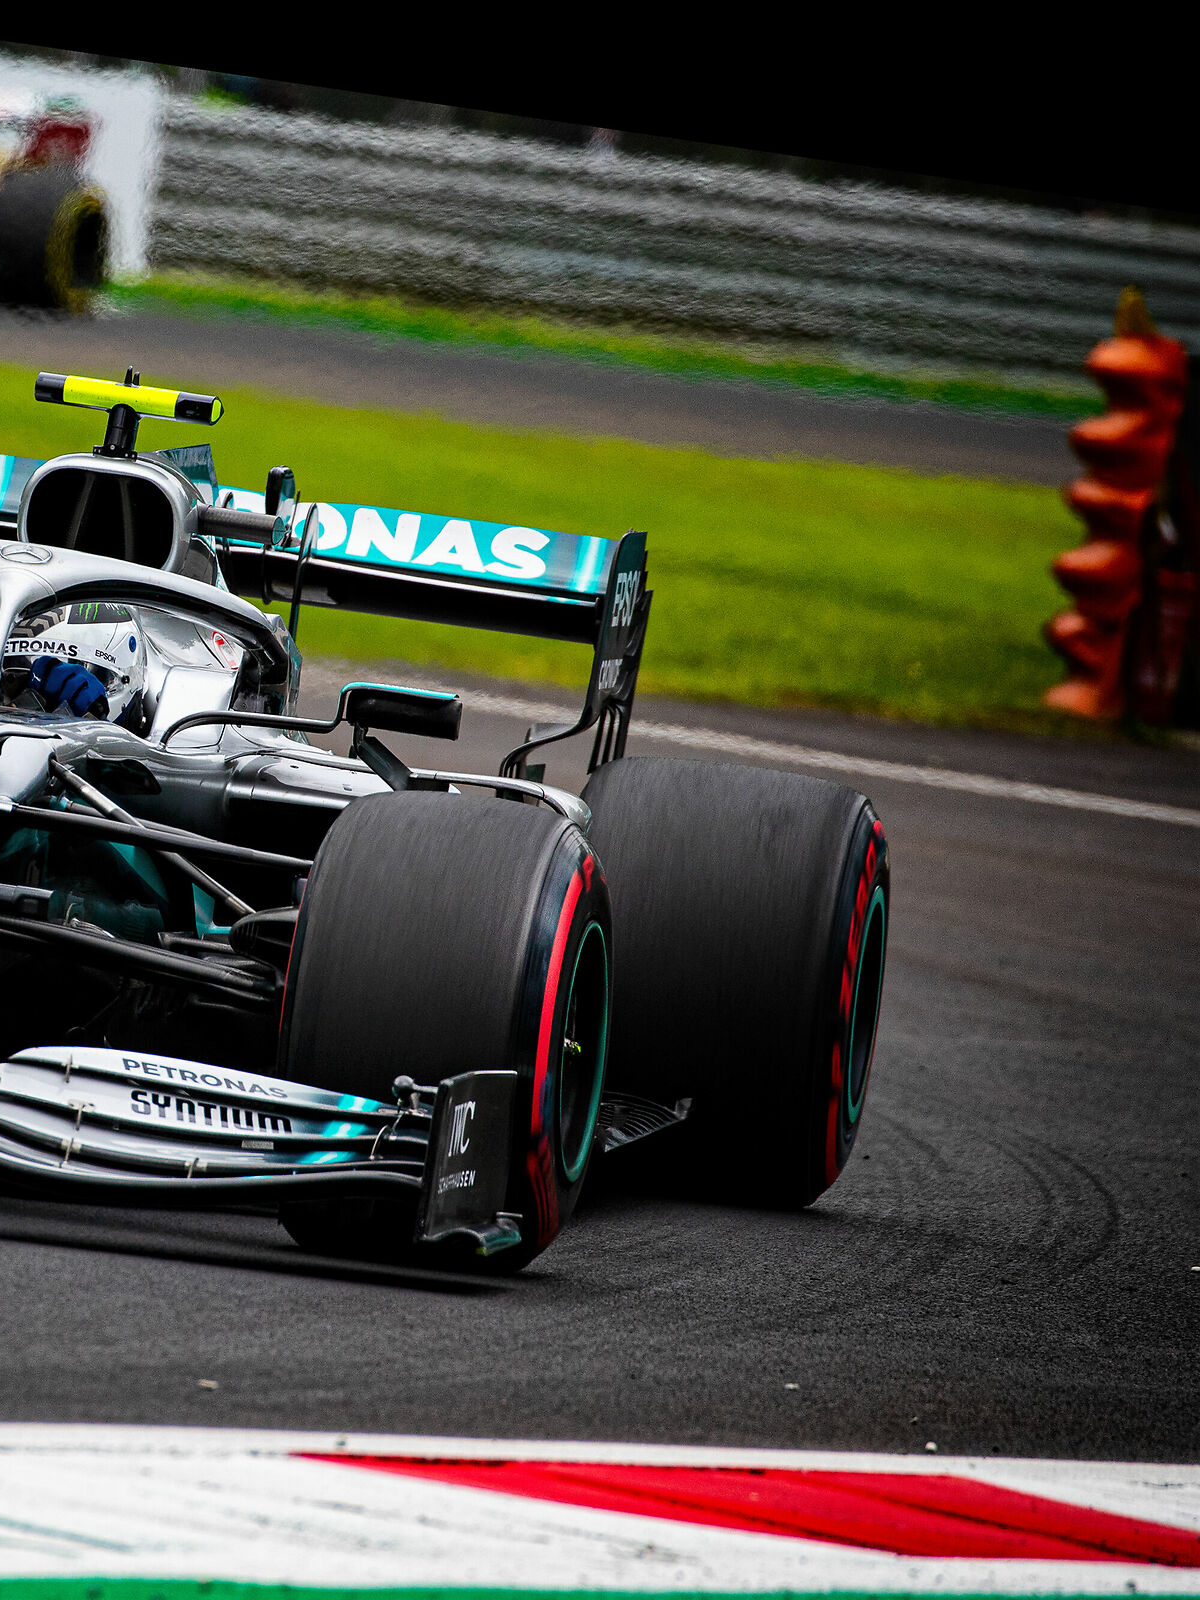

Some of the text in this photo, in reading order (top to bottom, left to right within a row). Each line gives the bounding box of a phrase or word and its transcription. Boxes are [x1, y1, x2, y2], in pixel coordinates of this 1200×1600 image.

[611, 571, 640, 627] EPSO
[95, 649, 117, 663] EPSON
[122, 1058, 288, 1099] PETRONAS
[131, 1089, 292, 1134] SYNTIUM
